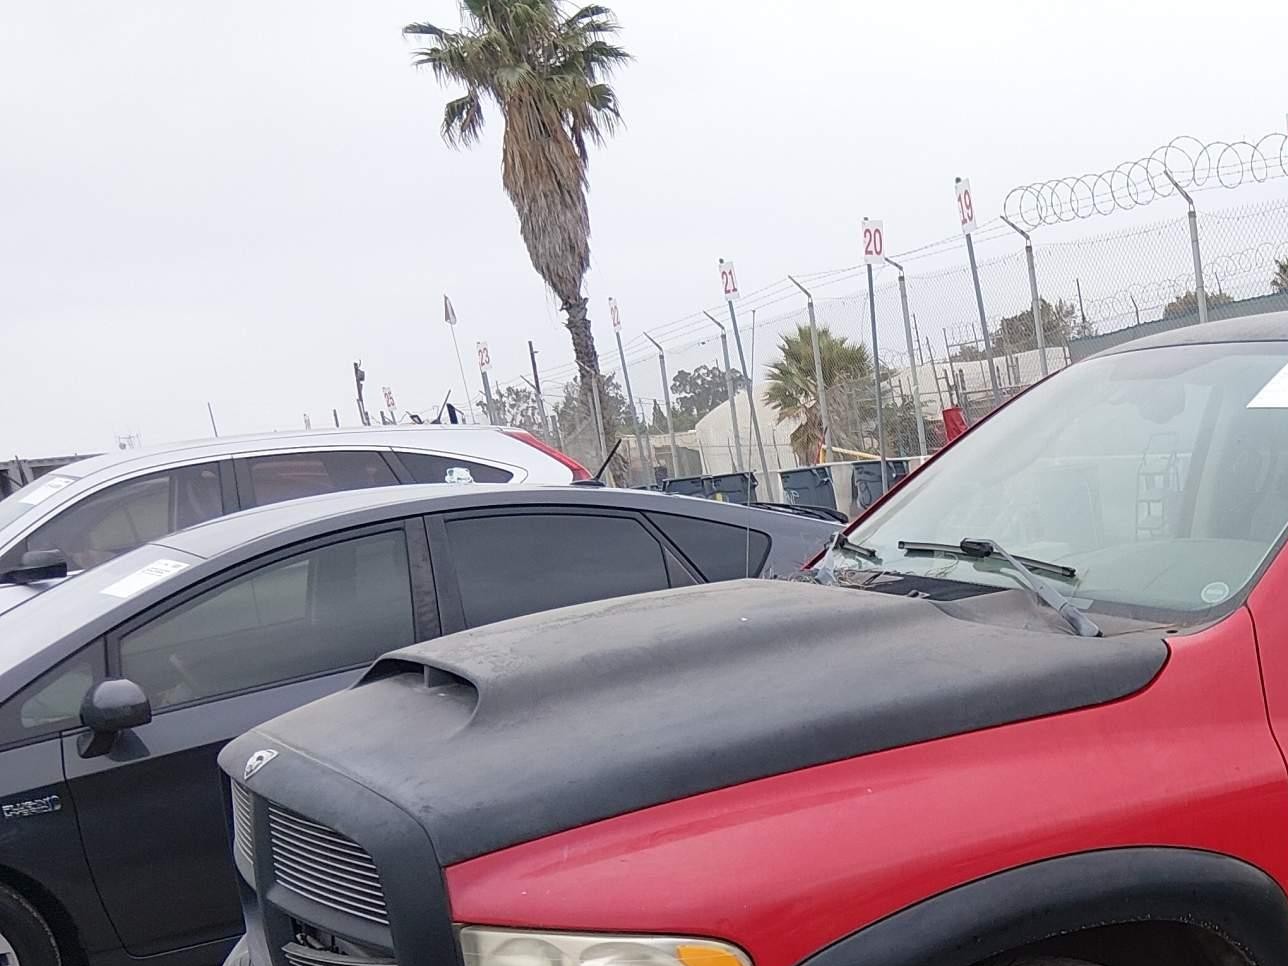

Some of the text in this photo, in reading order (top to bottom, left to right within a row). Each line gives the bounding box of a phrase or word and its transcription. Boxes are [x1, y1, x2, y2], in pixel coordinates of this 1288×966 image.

[957, 189, 974, 225] 19
[863, 228, 883, 256] 20
[721, 269, 738, 294] 21
[478, 347, 490, 367] 23
[384, 391, 395, 408] 25
